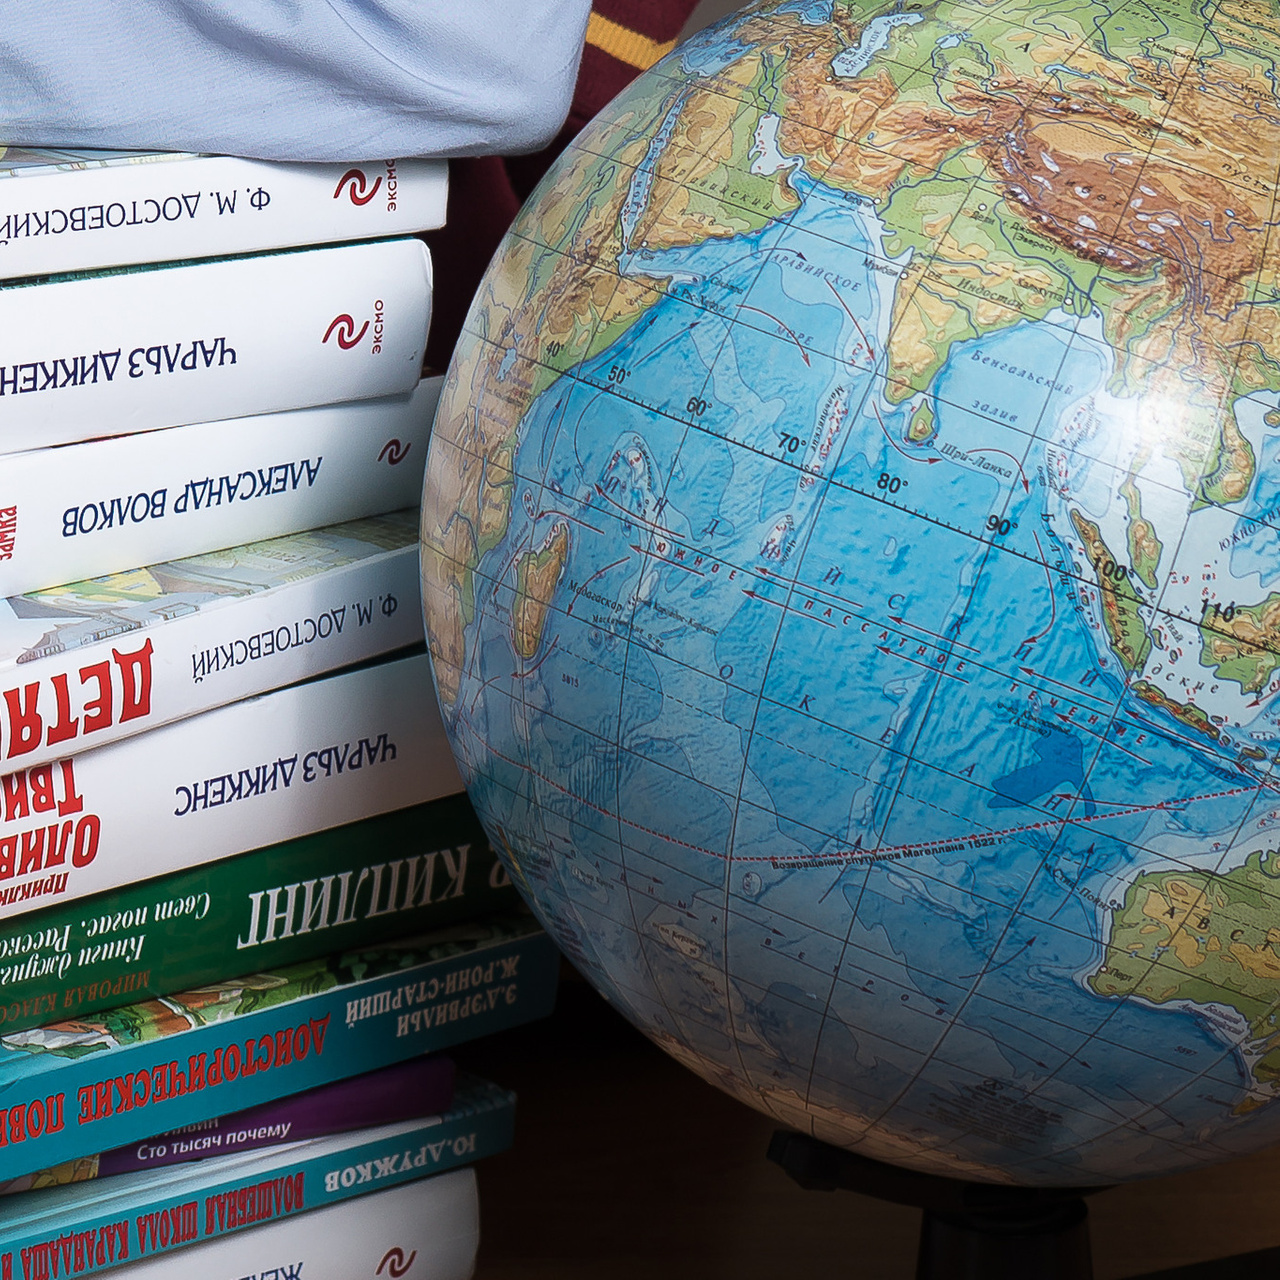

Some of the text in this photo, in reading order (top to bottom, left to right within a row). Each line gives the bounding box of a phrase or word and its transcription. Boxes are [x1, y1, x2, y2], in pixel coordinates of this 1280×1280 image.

[208, 189, 238, 216] М.
[245, 186, 272, 211] Ф.
[772, 253, 862, 293] АРАВИЙСКОЕ
[371, 299, 386, 355] ЭКСМО
[774, 326, 814, 346] МОРЕ
[128, 337, 238, 379] ЧАРЛЬЗ
[545, 340, 565, 358] 40°
[607, 365, 632, 385] 50°
[970, 349, 1074, 396] Бенгальский
[686, 396, 714, 417] 60°
[971, 399, 1020, 424] залив
[777, 431, 807, 454] 70°
[941, 442, 1013, 479] Шри-Ланка
[61, 456, 323, 538] АЛЕКСАНДР ВОЛКОВ
[876, 471, 909, 495] 80°
[986, 513, 1020, 537] 90°
[1092, 555, 1134, 583] 100°
[1200, 598, 1243, 624] 110°
[192, 593, 398, 684] Ф. М. ДОСТОЕВСКИЙ
[656, 540, 1147, 744] ЮЖНОЕ ПАССАТНОЕ ТЕЧЕНИЕ
[173, 733, 397, 817] ЧАРЛЬЗ ДИККЕНС
[771, 855, 844, 871] Возвращение
[845, 851, 901, 867] спутников
[902, 842, 966, 860] Магеллана
[968, 837, 995, 851] 1522
[154, 891, 212, 922] Свет
[236, 843, 471, 950] КИПЛИНГ
[81, 905, 149, 938] погас.
[77, 934, 147, 966] Книги
[63, 968, 152, 1008] МИРОВАЯ
[1109, 969, 1135, 983] Перт
[76, 1011, 332, 1126] ДОИСТОРИЧЕСКИЕ
[136, 1120, 292, 1161] Сто тысяч почему
[204, 1170, 305, 1237] ВОЛШЕБНАЯ
[136, 1199, 199, 1255] ШКОЛА
[1, 1251, 14, 1280] И
[20, 1218, 130, 1280] КАРАНДАША
